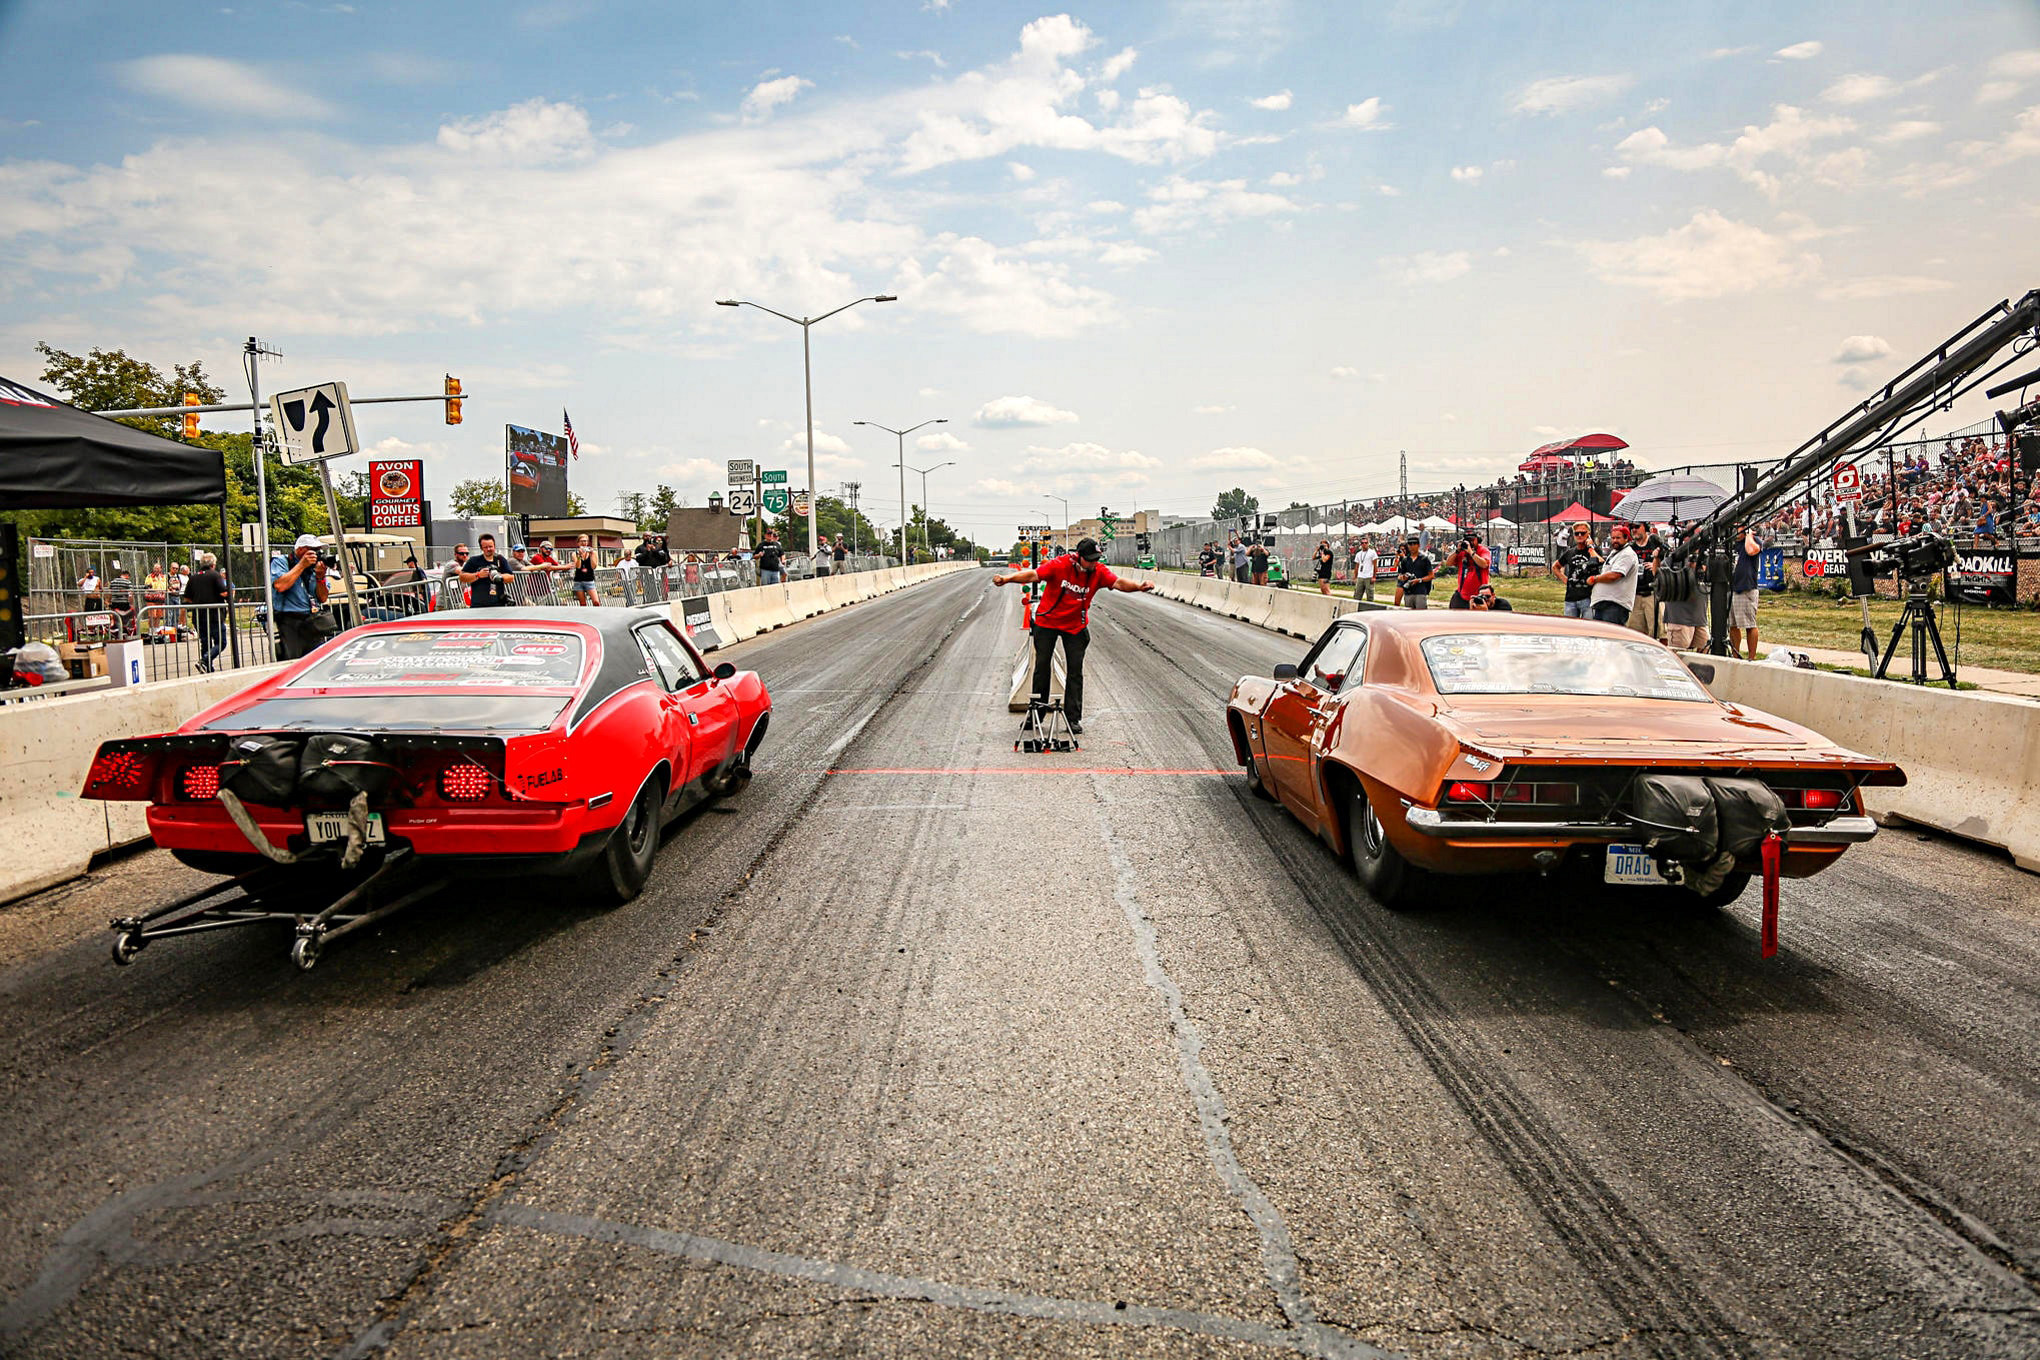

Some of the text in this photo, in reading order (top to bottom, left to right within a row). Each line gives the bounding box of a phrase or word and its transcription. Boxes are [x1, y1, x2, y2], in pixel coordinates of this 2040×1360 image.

[376, 462, 413, 471] AVON
[728, 462, 752, 471] SOUTH
[730, 475, 752, 483] BUSINESS
[763, 472, 785, 481] SOUTH
[732, 495, 752, 509] 24
[767, 496, 784, 509] 75
[372, 504, 420, 515] DONUTS
[375, 515, 418, 526] COFFEE
[1509, 547, 1545, 557] OVERDRIVE
[1823, 563, 1846, 574] GEAR
[503, 632, 567, 640] DIAMOND
[350, 640, 387, 651] 10
[527, 767, 563, 790] FUELAB
[1615, 855, 1651, 876] DRAG
